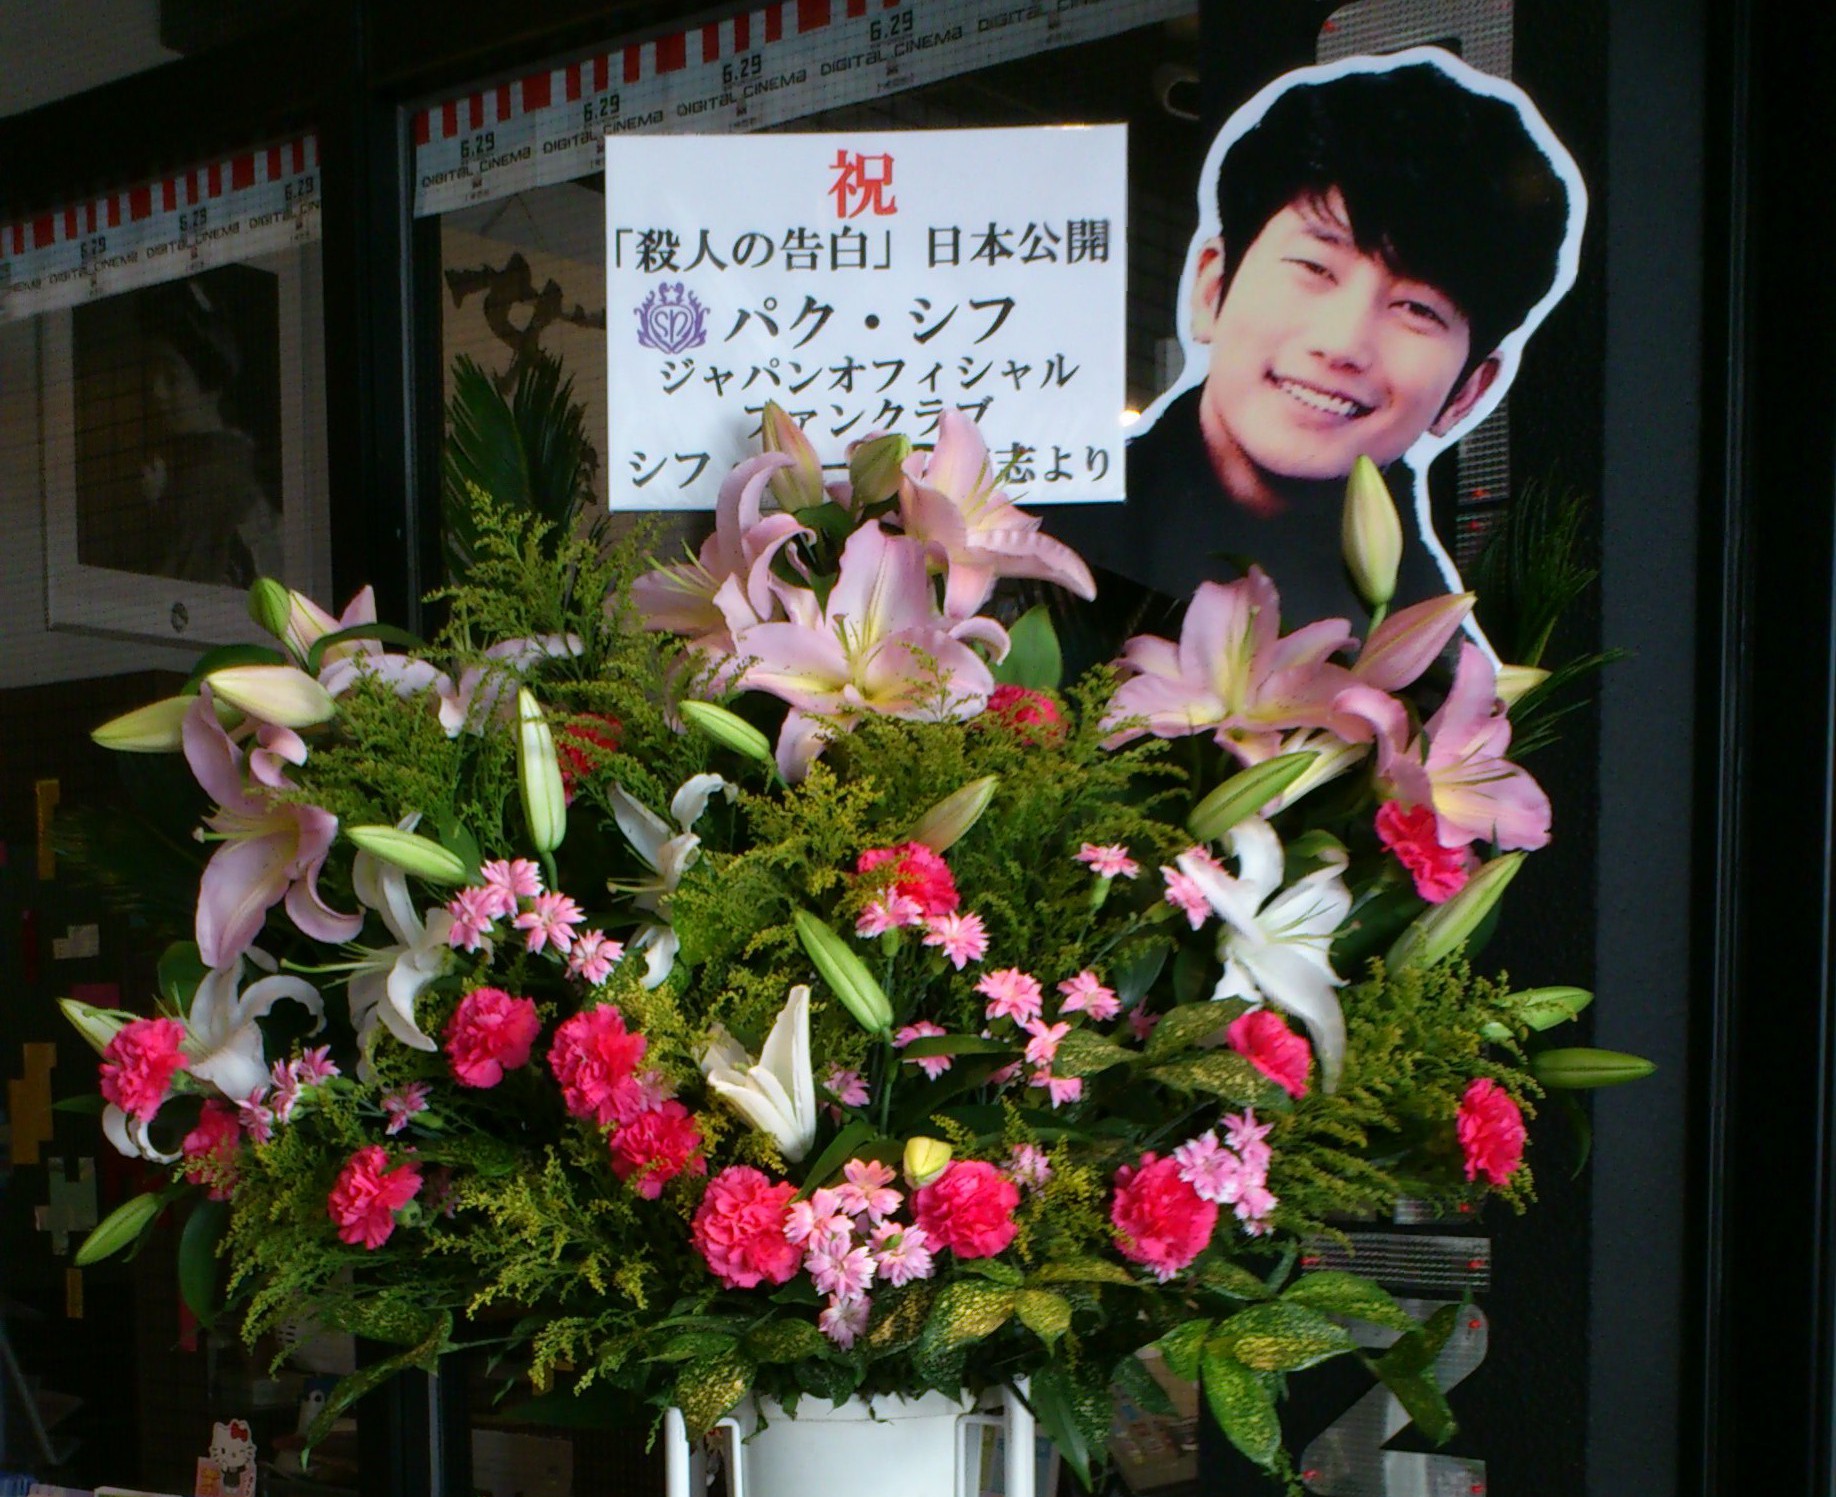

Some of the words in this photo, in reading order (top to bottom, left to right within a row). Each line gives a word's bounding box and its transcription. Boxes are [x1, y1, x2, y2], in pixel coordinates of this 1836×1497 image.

[870, 10, 913, 42] 6.29
[722, 55, 762, 84] 6.29
[584, 94, 620, 123] 6.29
[461, 131, 495, 159] 6.29
[827, 148, 898, 219] 祝
[615, 226, 892, 274] 「殺人の告白」
[927, 218, 1111, 268] 日本公開
[722, 294, 1017, 349] パク・シフ
[660, 353, 1081, 396] ジャパンオフィシャル
